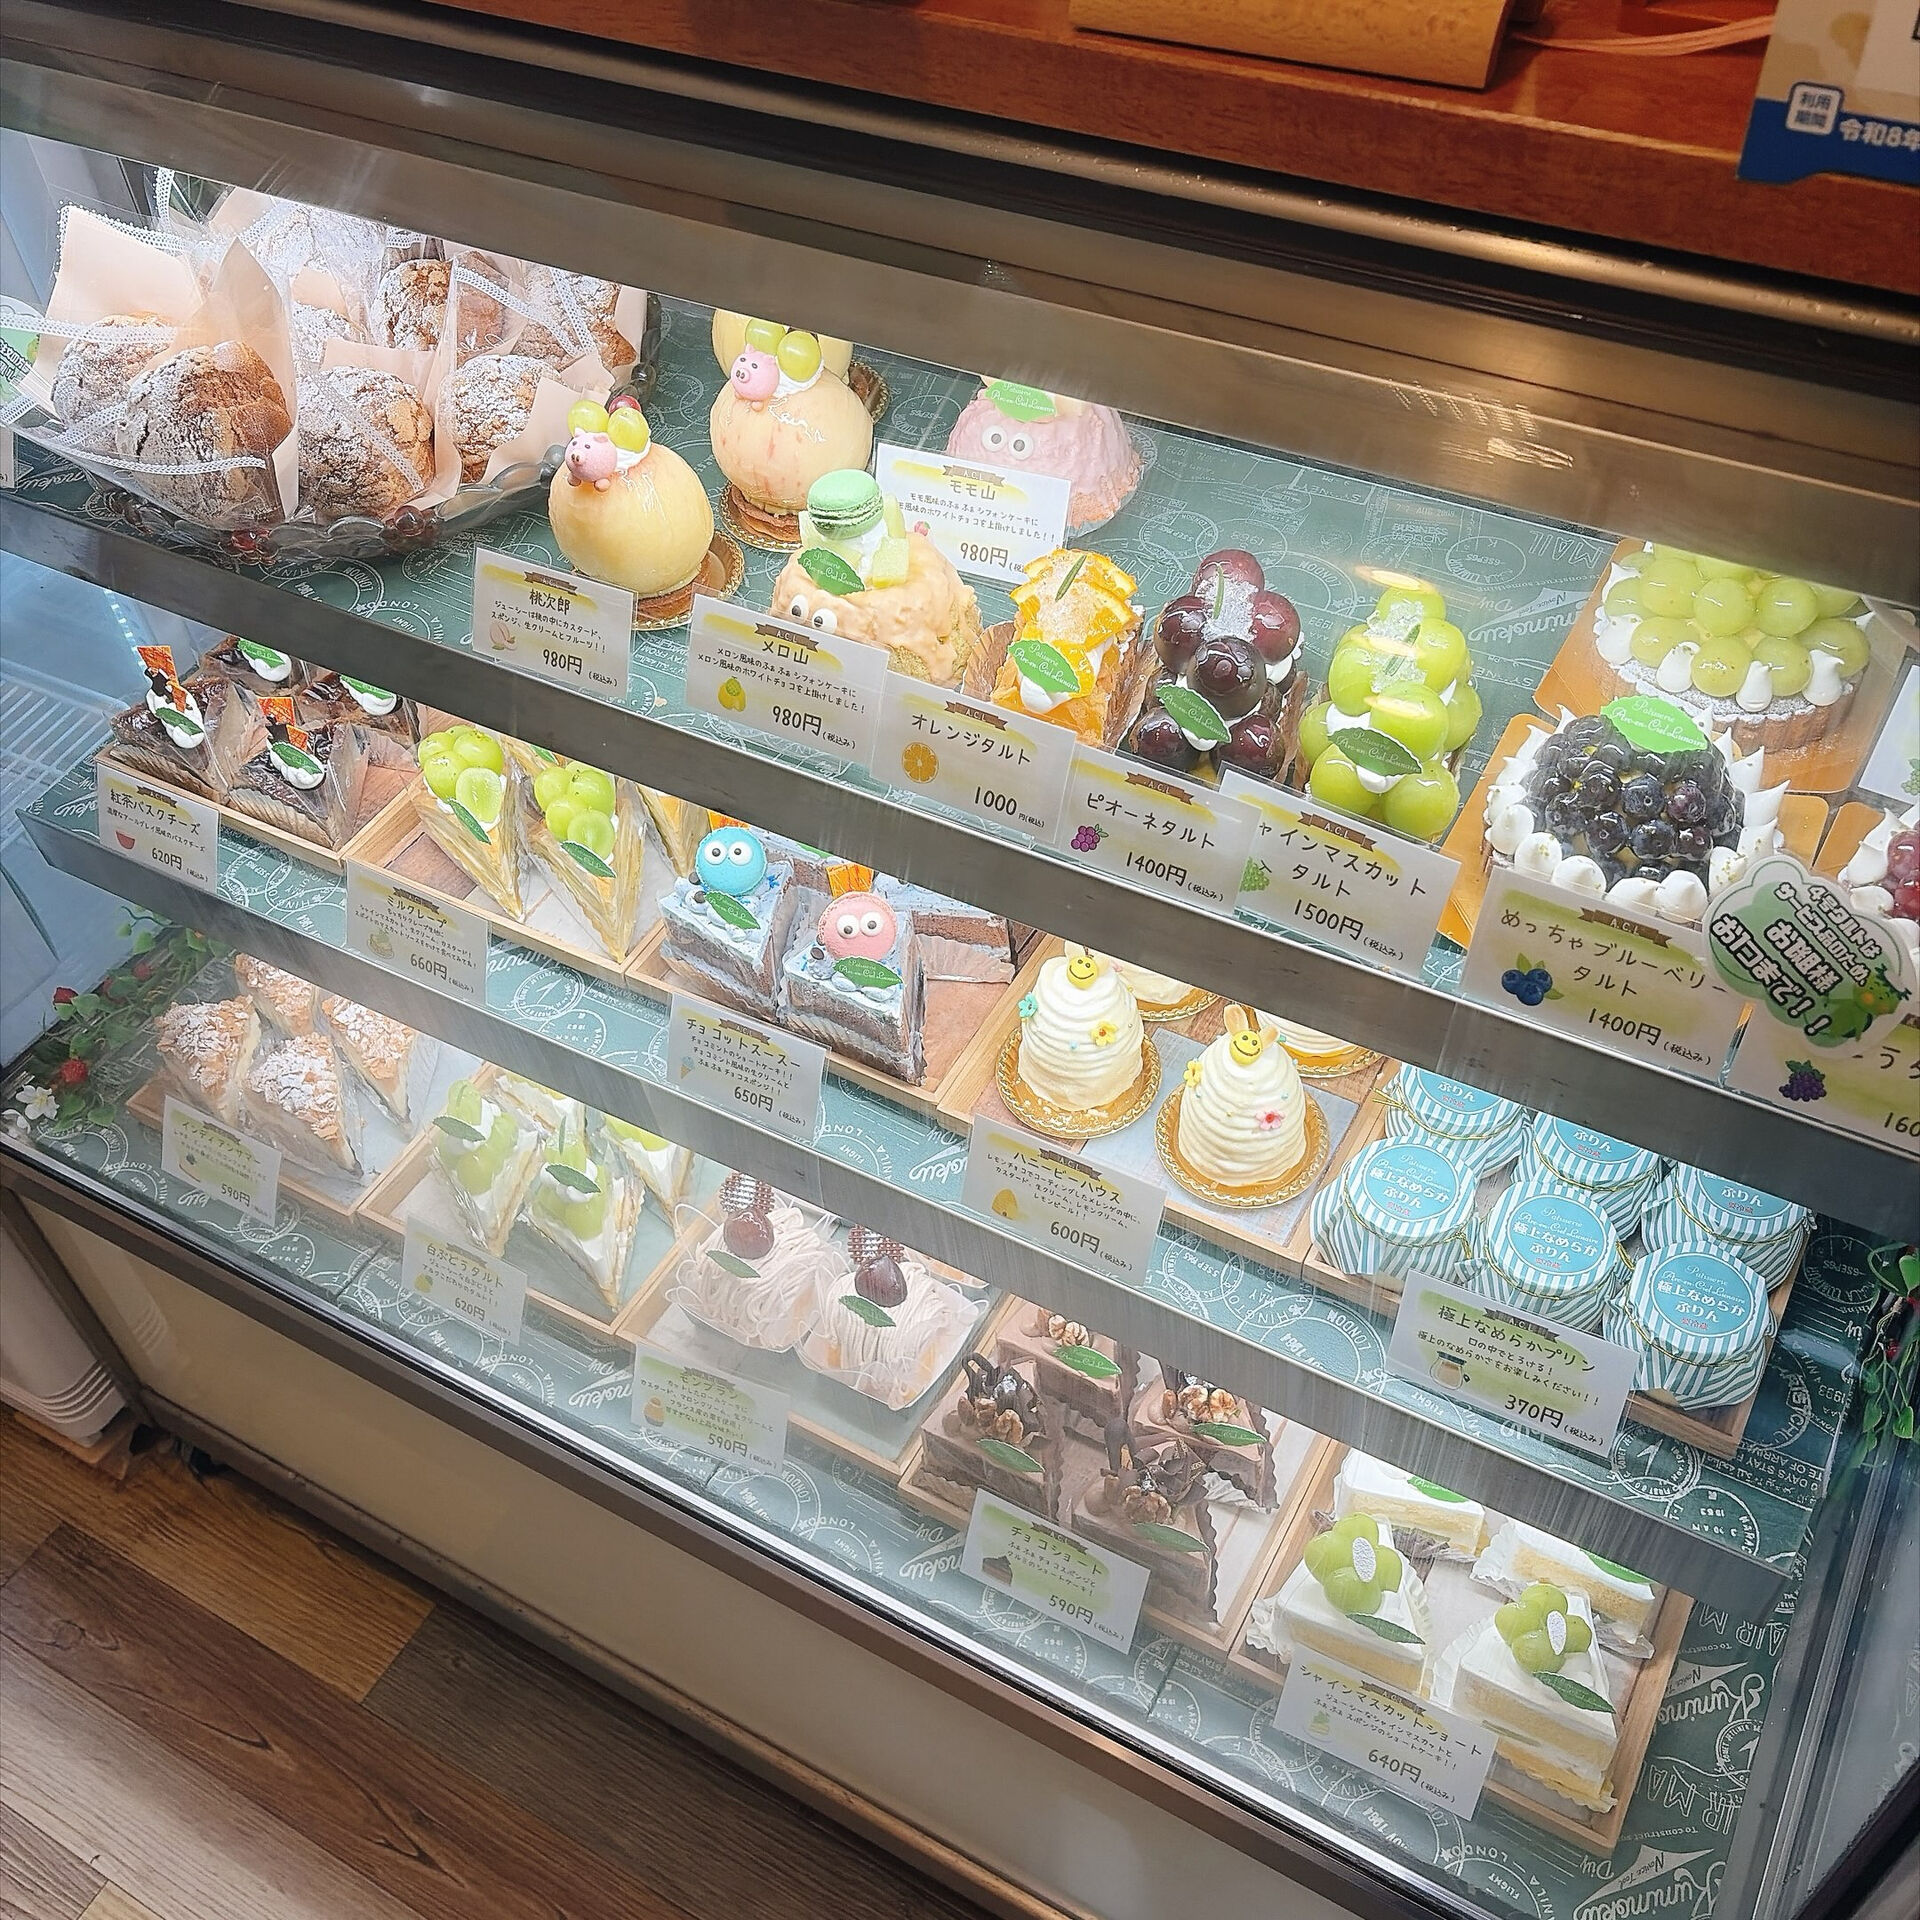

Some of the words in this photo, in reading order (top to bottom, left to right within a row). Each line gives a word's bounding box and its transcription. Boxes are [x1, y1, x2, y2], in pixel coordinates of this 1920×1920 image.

[1801, 91, 1832, 111] 利用
[1839, 118, 1920, 152] 令和8年
[949, 479, 996, 501] モモ山
[898, 501, 1056, 543] モ風味のホワイトチョコを上掛けしました！！
[960, 542, 1009, 569] 980円
[529, 588, 571, 615] 桃次郎
[491, 611, 607, 653] スポンジ、生クリームとフルーツ！！
[543, 649, 583, 675] 980円
[762, 640, 809, 665] メロ山
[698, 653, 866, 714] メロン風味のホワイトチョコを上掛けしました！
[772, 705, 822, 737] 980円
[911, 713, 1032, 766] オレンジタルト
[110, 788, 201, 836] 紅茶バスクチーズ
[974, 786, 1018, 816] 1000
[1087, 792, 1216, 850] ピオーネタルト
[151, 847, 183, 871] 620円
[1258, 821, 1426, 897] ャインマスカット
[1126, 851, 1188, 888] 1400円
[1187, 881, 1224, 902] (税込み)
[1292, 864, 1351, 897] タルト
[387, 894, 448, 929] ミルクレープ
[1806, 885, 1882, 961] 4号タルトは
[1293, 898, 1364, 941] 1500円
[1363, 936, 1405, 961] (税込み)
[1773, 882, 1872, 987] サービス品のため、
[410, 953, 448, 981] 660円
[1500, 909, 1729, 994] めっちゃブルーベリー
[1574, 965, 1638, 998] タルト
[686, 1017, 801, 1069] チョコットスースー
[1588, 1008, 1662, 1047] 1400円
[1662, 1041, 1712, 1067] (税込み)
[734, 1086, 774, 1113] 650円
[1438, 1081, 1475, 1102] ぷりん
[1572, 1129, 1612, 1153] ぷりん
[221, 1184, 250, 1207] 590円
[1013, 1151, 1123, 1206] ハニービーハウス
[1369, 1166, 1450, 1203] 極上なめらか
[1383, 1186, 1422, 1209] ぷりん
[1720, 1185, 1763, 1208] ぷりん
[1050, 1220, 1100, 1254] 600円
[1512, 1221, 1599, 1257] 極上なめらか
[1529, 1240, 1571, 1264] ぷりん
[427, 1243, 504, 1288] 白ぶどうタルト
[455, 1297, 486, 1321] 620円
[1656, 1279, 1746, 1317] 極上なめらか
[1675, 1301, 1719, 1323] ぷりん
[1438, 1304, 1595, 1372] 極上なめらかプリン
[1417, 1330, 1600, 1406] 極上のなめらかさをお楽しみください！！
[1467, 1337, 1553, 1376] 口の中でとろける！
[680, 1374, 739, 1399] モンブラン
[1504, 1394, 1564, 1429] 370円
[1563, 1423, 1604, 1447] (税込み)
[708, 1433, 748, 1457] 590円
[1746, 1457, 1775, 1475] STAY
[1777, 1470, 1808, 1487] DAYS
[1011, 1526, 1103, 1576] チョコショート
[1049, 1595, 1093, 1625] 590円
[1300, 1664, 1483, 1758] シャインマスカットショート
[1325, 1692, 1453, 1759] ジューシーなシャインマスカットと
[1368, 1749, 1422, 1784] 640円
